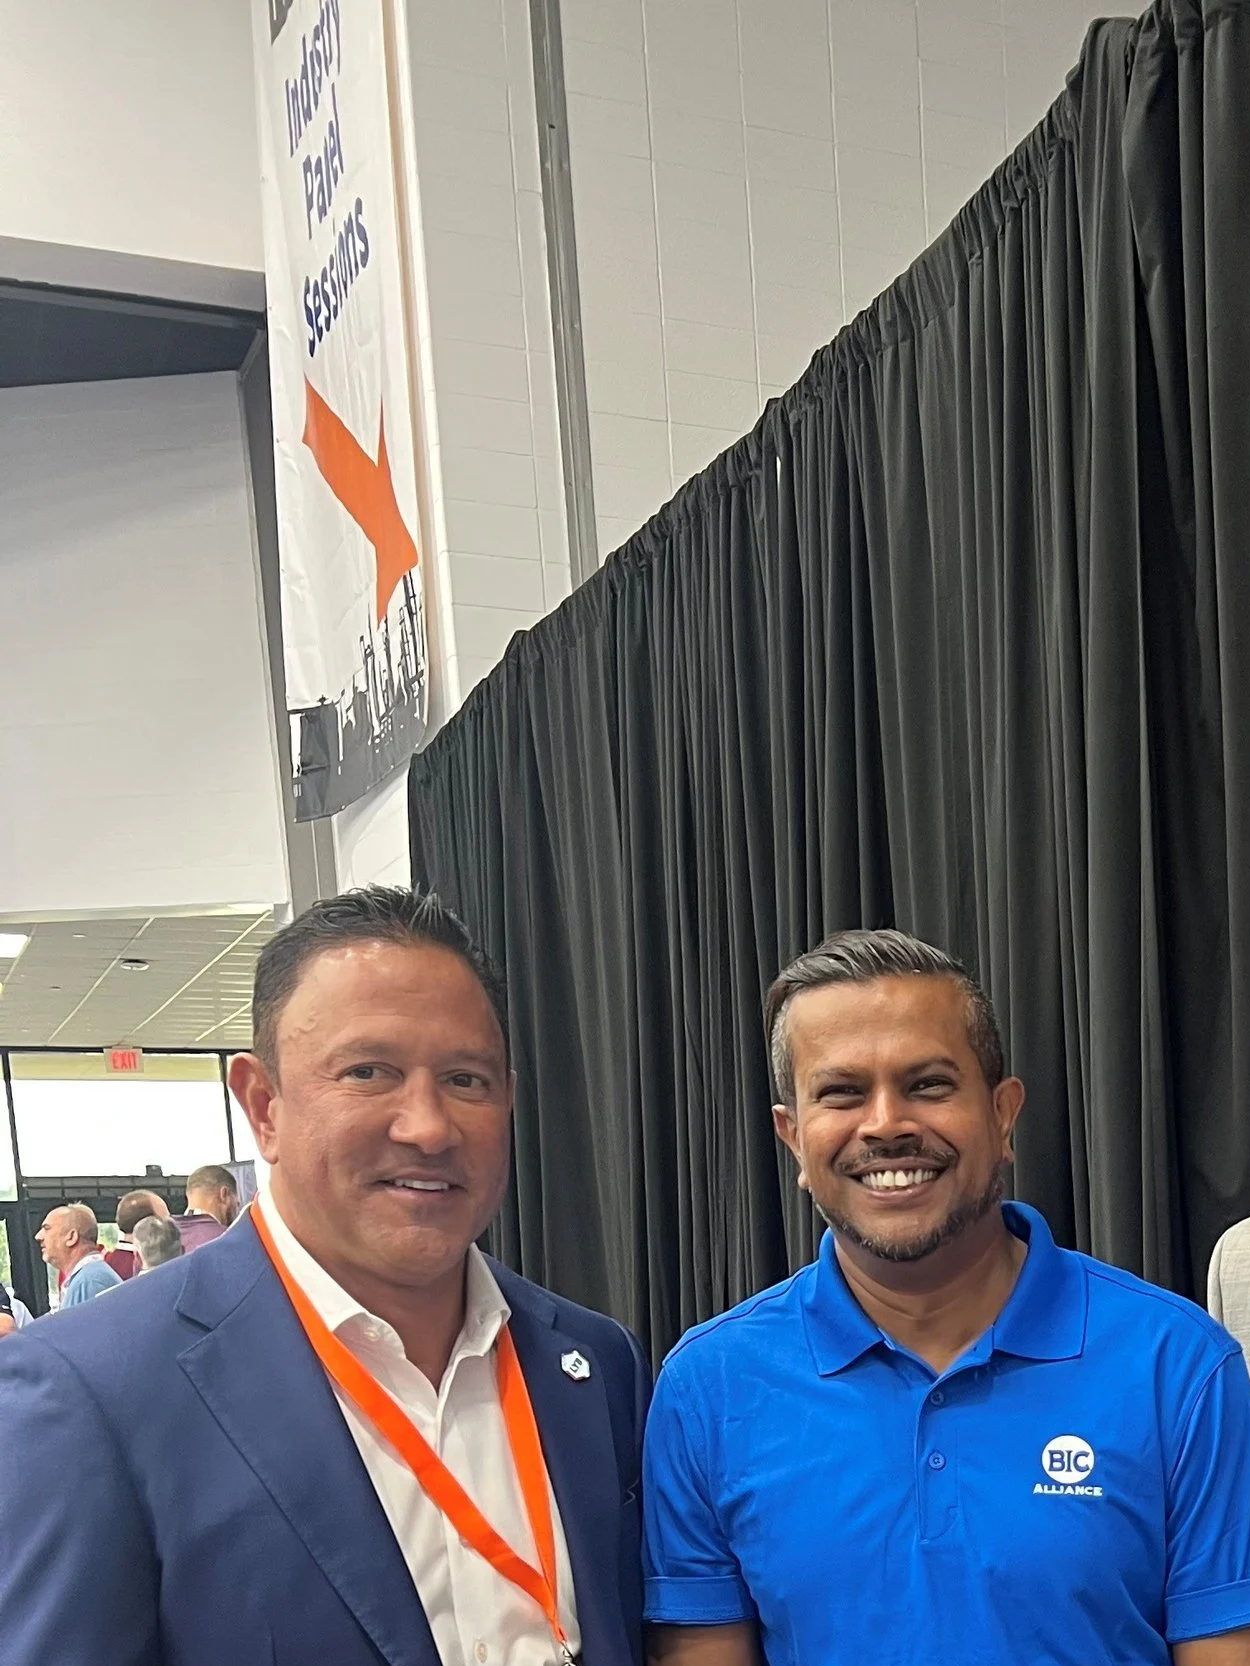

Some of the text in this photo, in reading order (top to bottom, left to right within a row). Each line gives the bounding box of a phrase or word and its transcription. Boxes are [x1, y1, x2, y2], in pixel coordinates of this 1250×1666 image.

[303, 196, 370, 358] Sessions
[111, 1051, 137, 1070] EXIT
[569, 1357, 583, 1374] LYB
[1047, 1449, 1091, 1473] BIC
[1032, 1483, 1103, 1497] ALLIANCE
